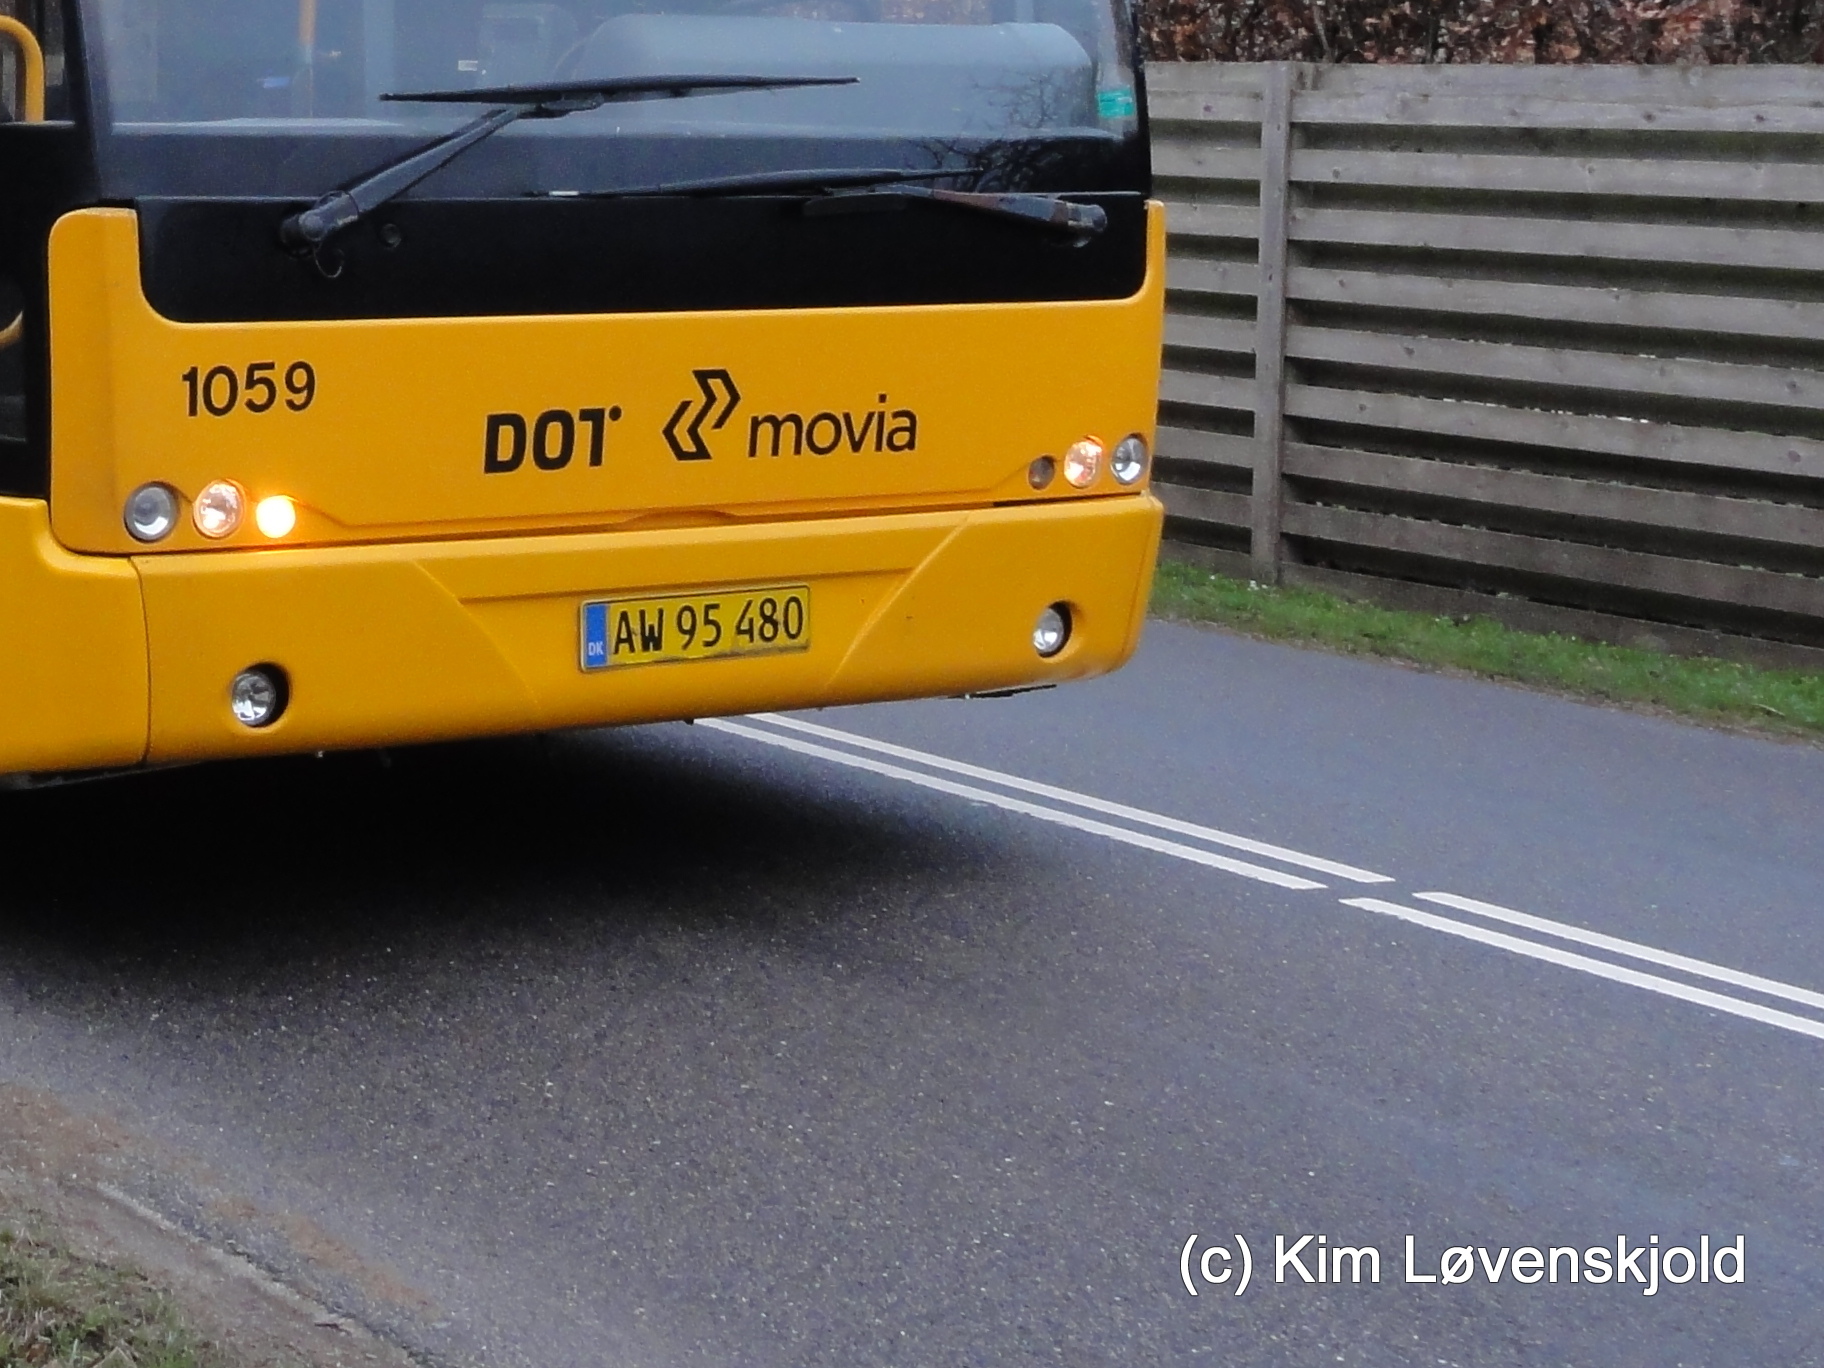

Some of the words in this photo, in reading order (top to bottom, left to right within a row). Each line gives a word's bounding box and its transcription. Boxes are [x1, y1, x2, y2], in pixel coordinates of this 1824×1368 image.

[182, 361, 316, 417] 1059
[484, 405, 622, 474] DOT
[748, 393, 917, 458] movia
[588, 641, 604, 657] DK
[613, 607, 664, 655] AW
[676, 604, 722, 650] 95
[735, 596, 804, 643] 480
